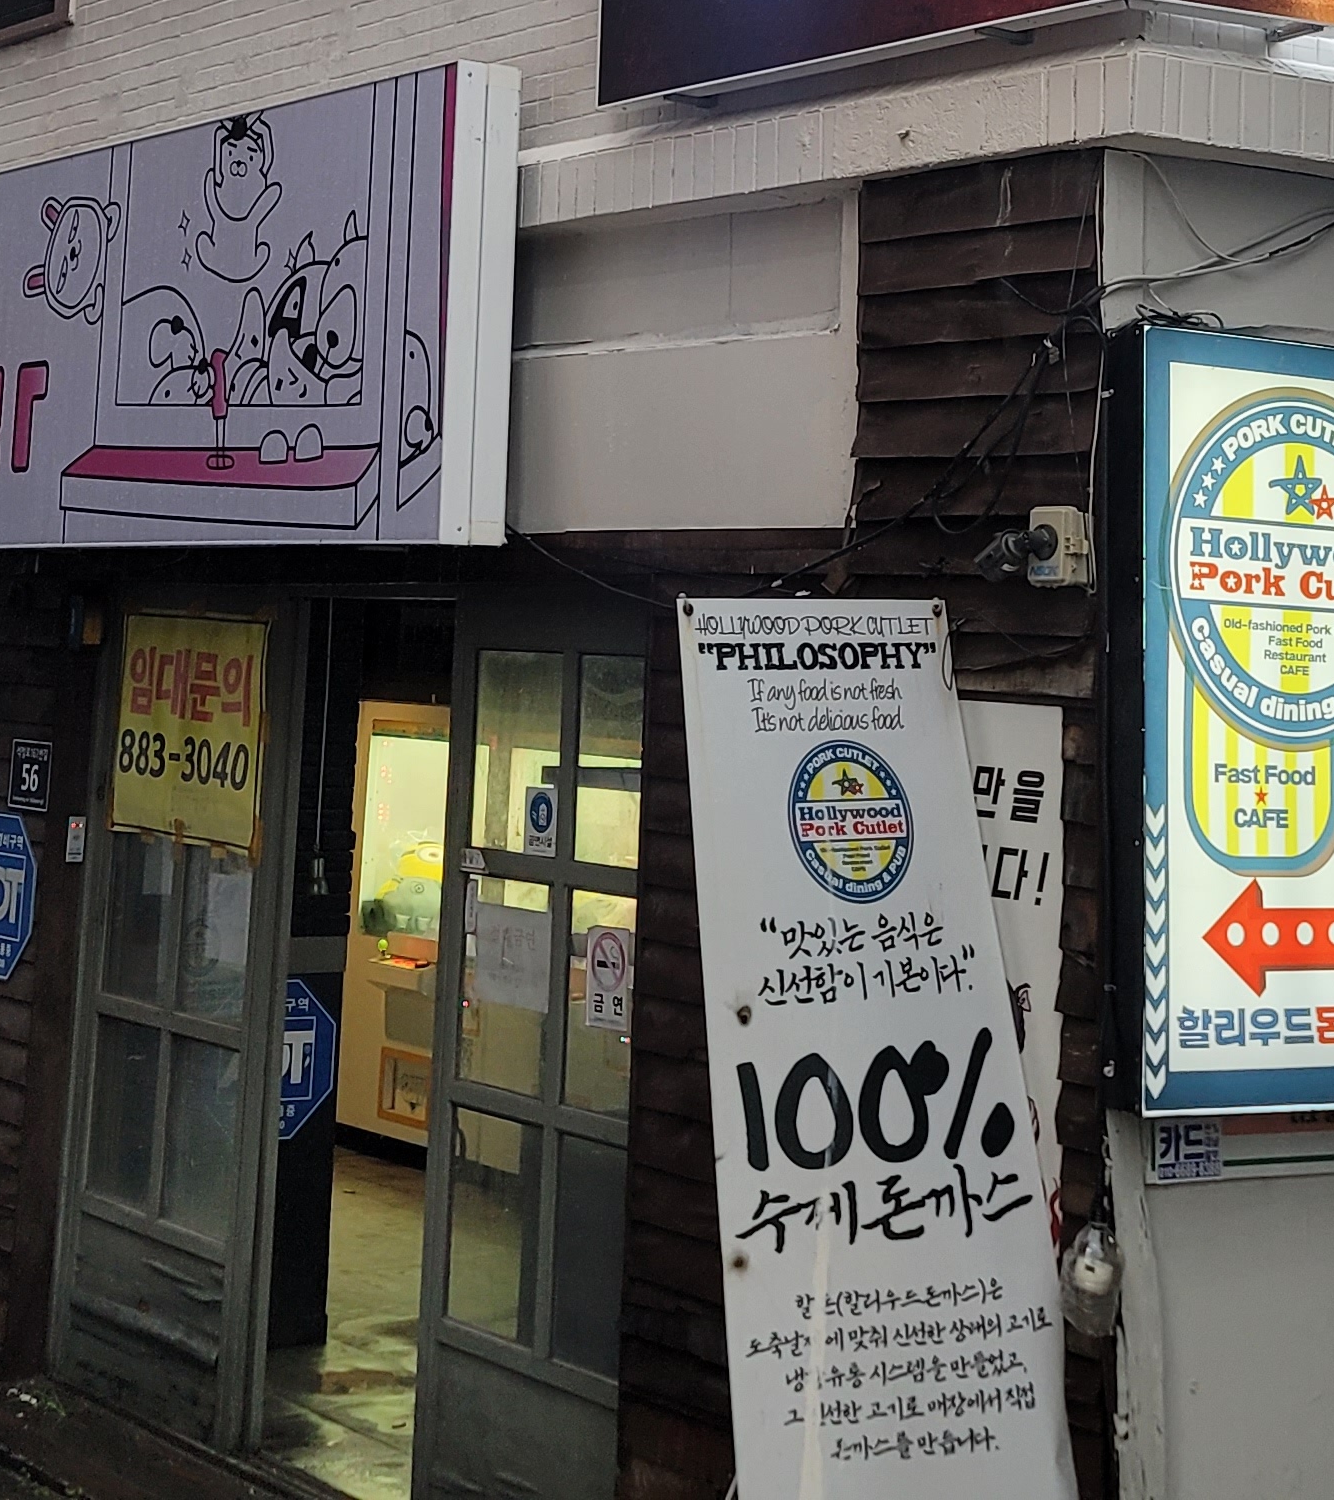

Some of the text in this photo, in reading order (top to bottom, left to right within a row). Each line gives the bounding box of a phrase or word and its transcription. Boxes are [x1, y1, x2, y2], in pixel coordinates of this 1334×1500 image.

[1223, 413, 1287, 462] PORK
[1189, 562, 1286, 597] Pork
[695, 614, 934, 639] HOLLYWOOD PORK CUTLET
[1224, 618, 1303, 634] Old-fashioned
[1305, 623, 1333, 636] Pork
[1268, 636, 1323, 649] Fast Food
[1191, 616, 1258, 709] Casual
[1264, 649, 1327, 663] Restaurant
[1280, 664, 1310, 676] CAFE
[130, 646, 254, 727] 임대문의
[748, 678, 904, 710] If any food is not fresh
[778, 708, 805, 733] not
[119, 728, 249, 791] 883-3040
[806, 747, 880, 774] PORK CUTLET
[1214, 763, 1316, 786] Fast Food
[21, 764, 39, 792] 56
[798, 803, 902, 823] Hollywood
[800, 820, 904, 837] Pork Cutlet
[1234, 808, 1289, 829] CAFE
[845, 880, 883, 894] dining
[889, 845, 906, 874] PUB
[871, 911, 944, 952] 음식은
[758, 962, 869, 1007] 신선함이
[736, 1027, 1015, 1172] 100%
[1159, 1124, 1203, 1161] 카드
[892, 1320, 946, 1347] 신선한
[949, 1312, 1002, 1343] 상태의
[1006, 1306, 1055, 1334] 고기로
[869, 1354, 947, 1387] 시스템을
[866, 1395, 925, 1422] 고기로
[927, 1387, 1002, 1418] 매장에서
[1005, 1381, 1036, 1411] 직접
